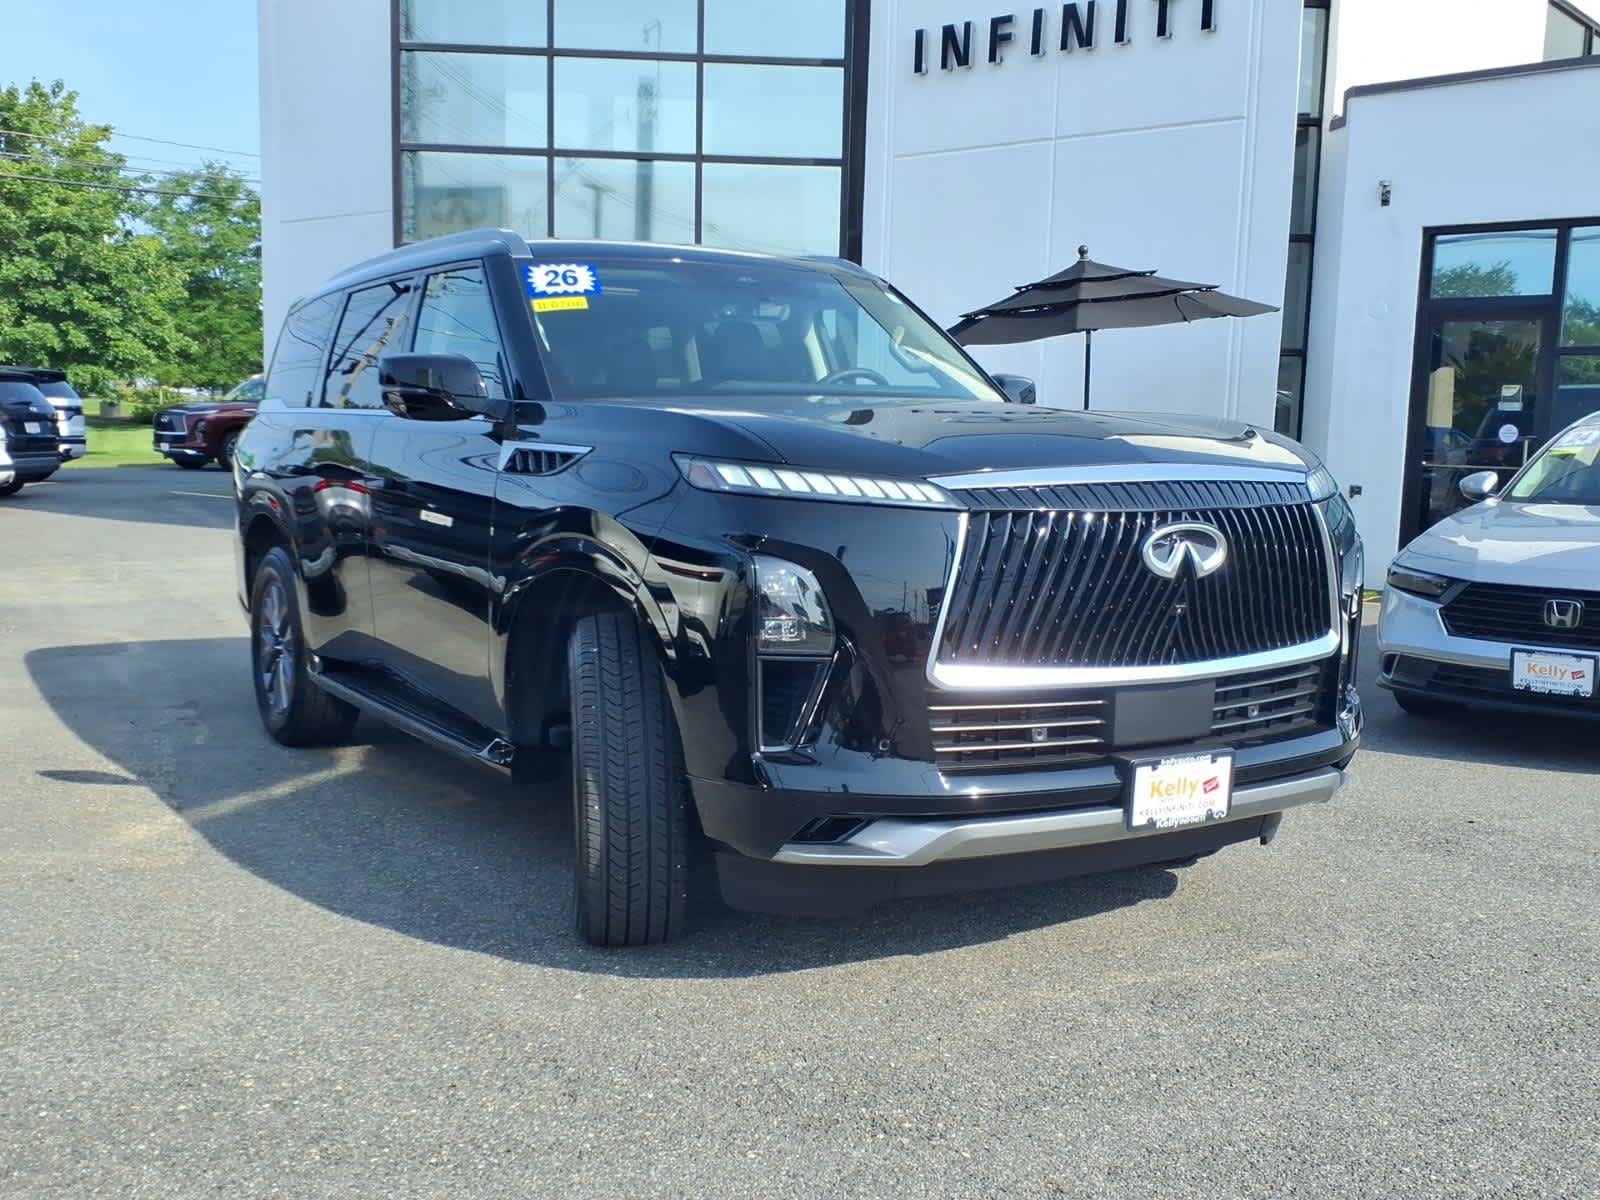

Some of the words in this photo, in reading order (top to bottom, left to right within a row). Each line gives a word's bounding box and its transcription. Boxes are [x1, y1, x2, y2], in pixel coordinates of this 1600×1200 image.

[913, 0, 1214, 74] INFINITI
[544, 269, 578, 287] 26
[1527, 662, 1568, 680] Kelly
[1150, 777, 1199, 798] Kelly
